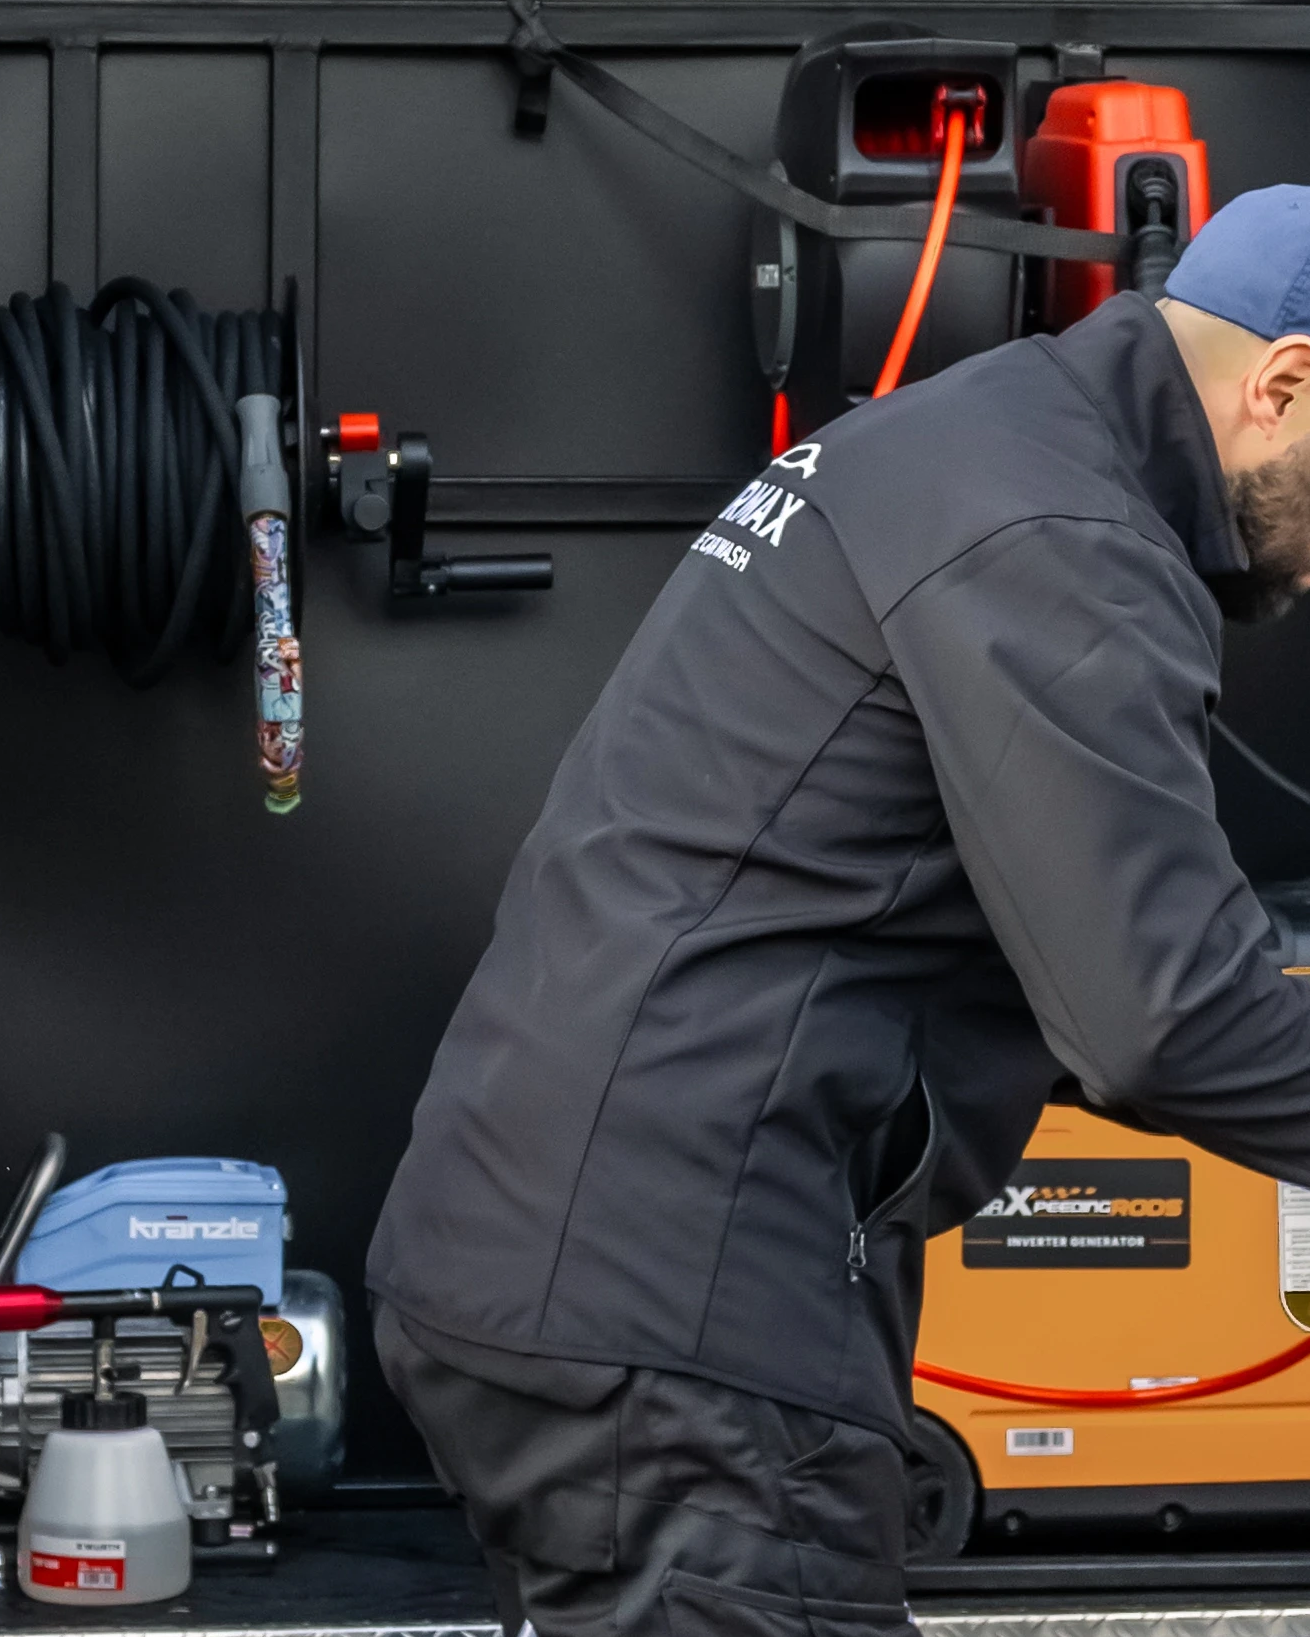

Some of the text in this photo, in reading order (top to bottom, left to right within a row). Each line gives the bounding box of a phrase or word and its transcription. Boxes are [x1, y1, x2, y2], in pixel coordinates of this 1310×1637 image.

[718, 480, 806, 547] RMAX
[712, 538, 752, 573] WASH
[1006, 1235, 1146, 1248] INVERTER GENERATOR
